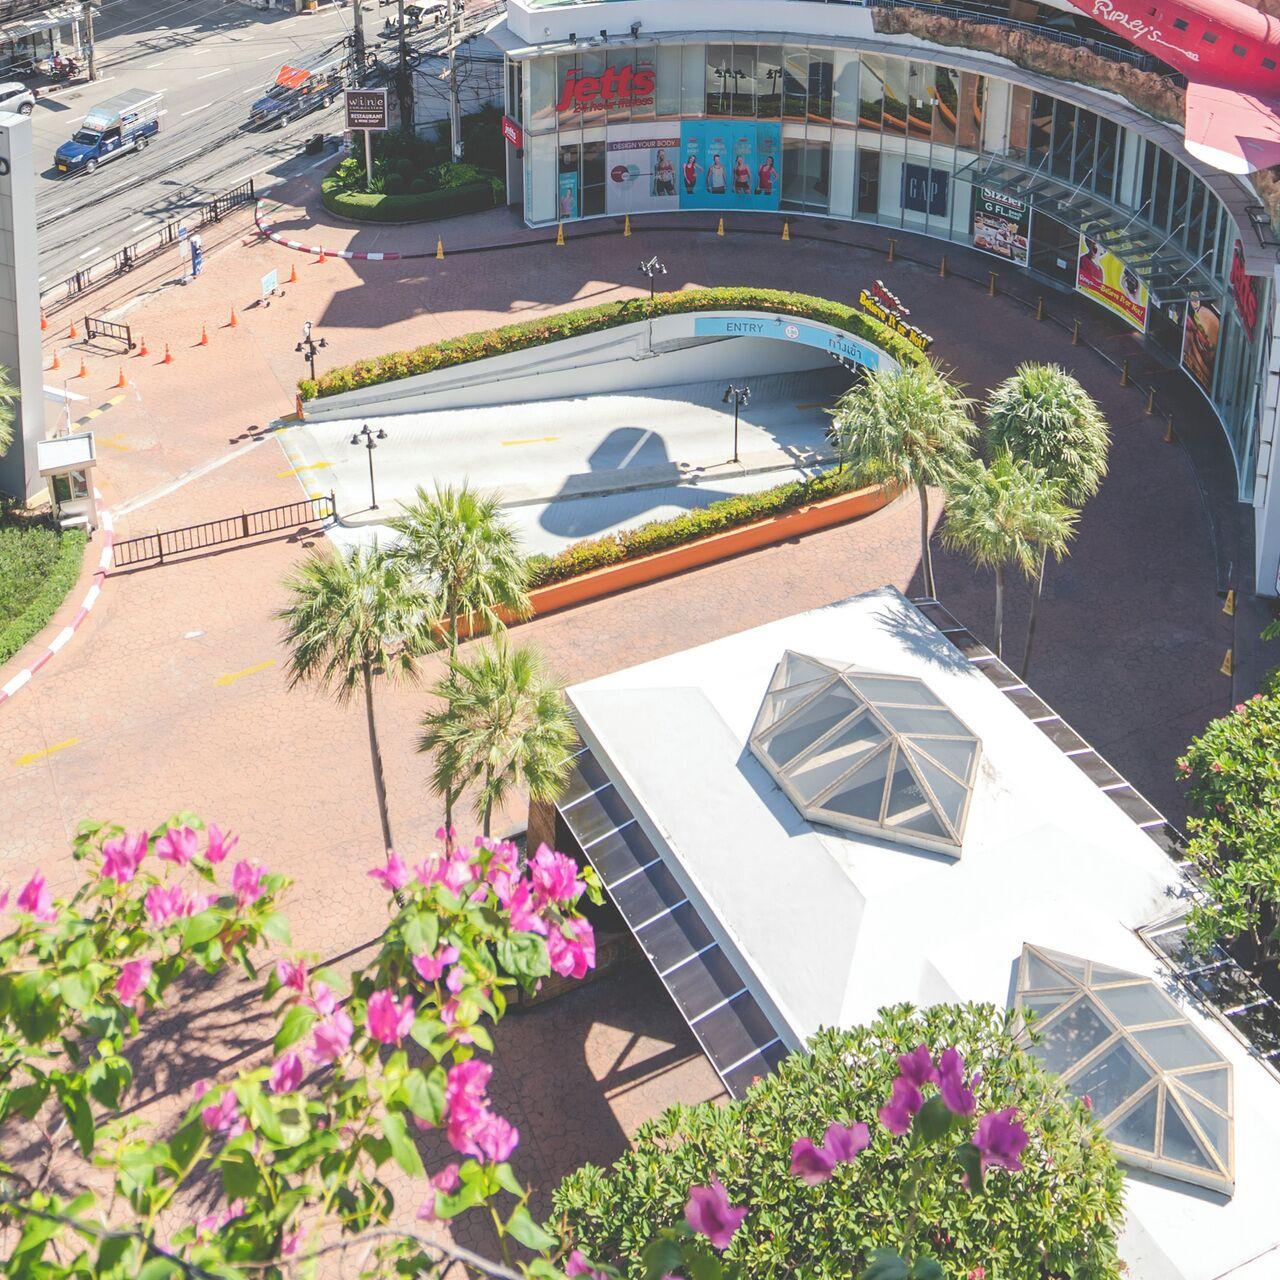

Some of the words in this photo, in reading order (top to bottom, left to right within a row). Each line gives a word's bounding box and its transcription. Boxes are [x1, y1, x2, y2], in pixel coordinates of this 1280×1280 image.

[556, 64, 656, 112] jetts
[613, 142, 637, 150] DESIGN
[638, 140, 656, 148] YOUR
[657, 139, 676, 147] BODY
[909, 177, 938, 202] GAP
[985, 202, 993, 211] G
[726, 322, 764, 333] ENTRY
[829, 338, 863, 360] ทางเข้า
